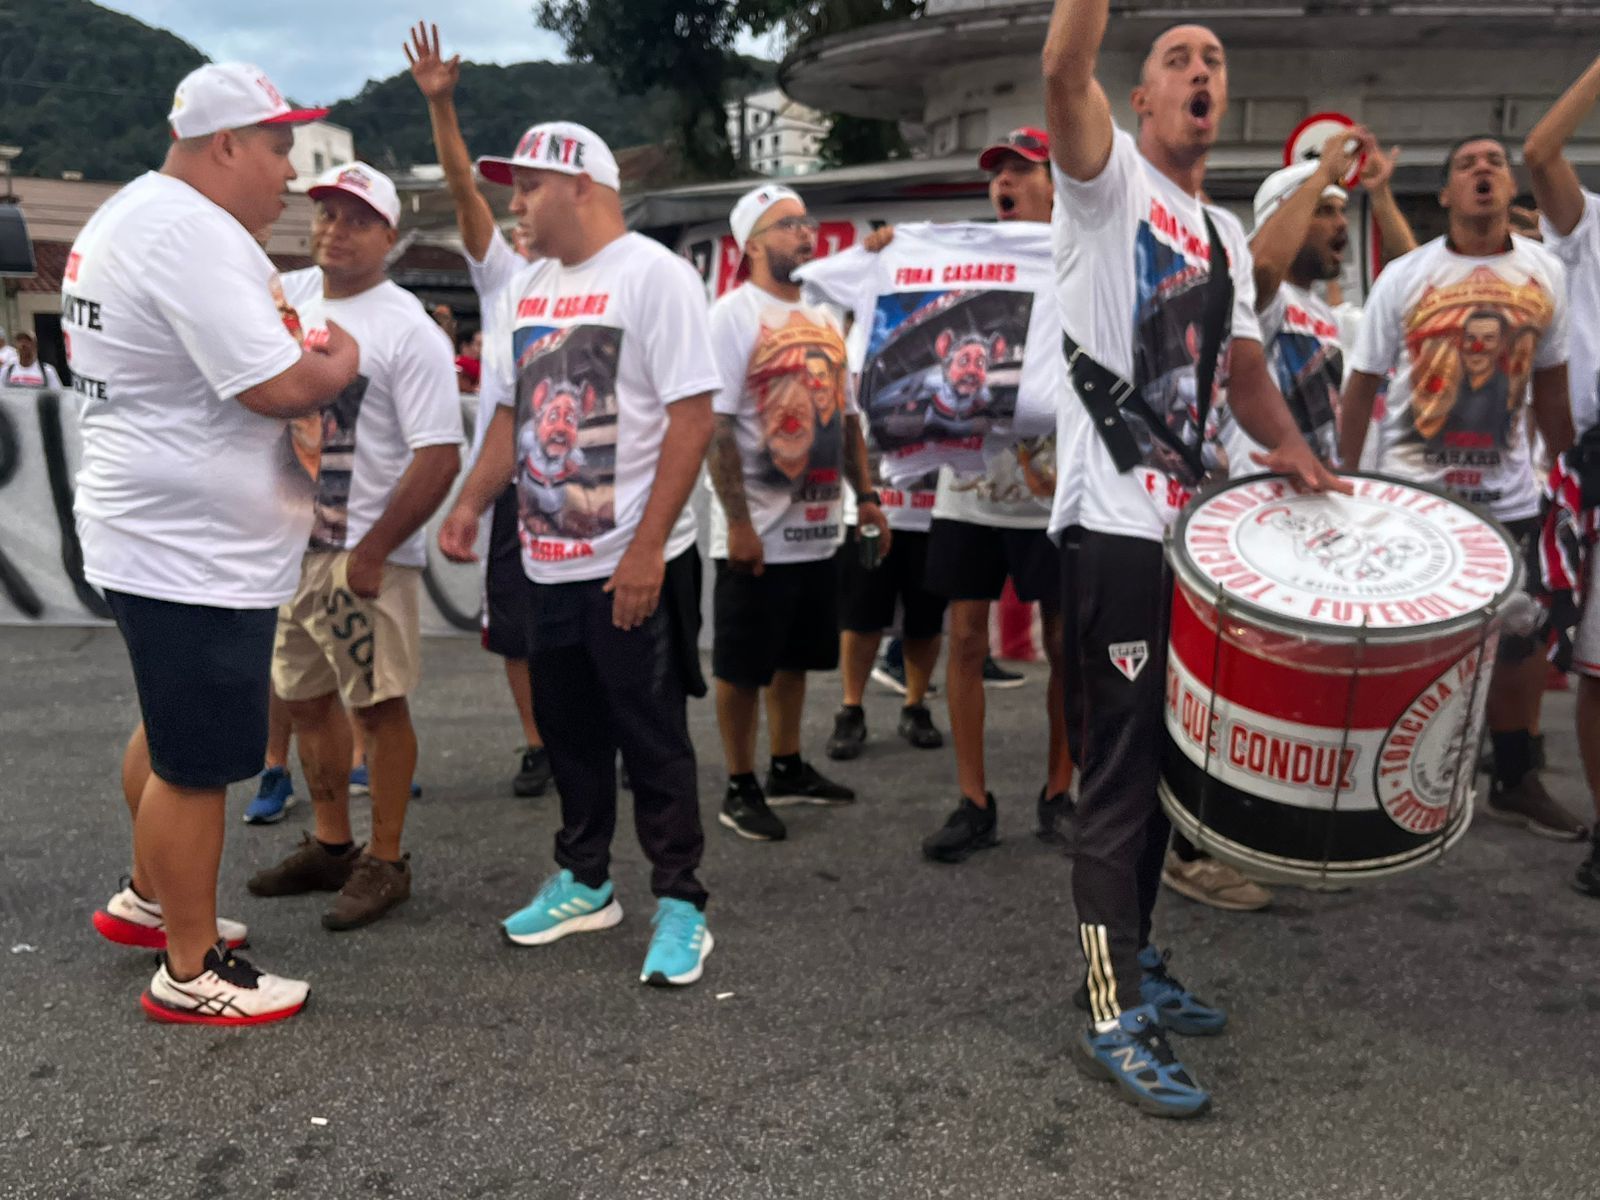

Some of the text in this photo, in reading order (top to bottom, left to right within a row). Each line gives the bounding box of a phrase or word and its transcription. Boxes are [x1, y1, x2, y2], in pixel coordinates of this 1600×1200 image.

[942, 263, 1016, 283] CASARES
[1201, 477, 1448, 521] INDEPENTE
[1309, 592, 1469, 625] FUTEBOL
[1182, 690, 1219, 753] QUE
[1230, 725, 1355, 788] CONDUZ
[1380, 680, 1453, 777] TORCIDA
